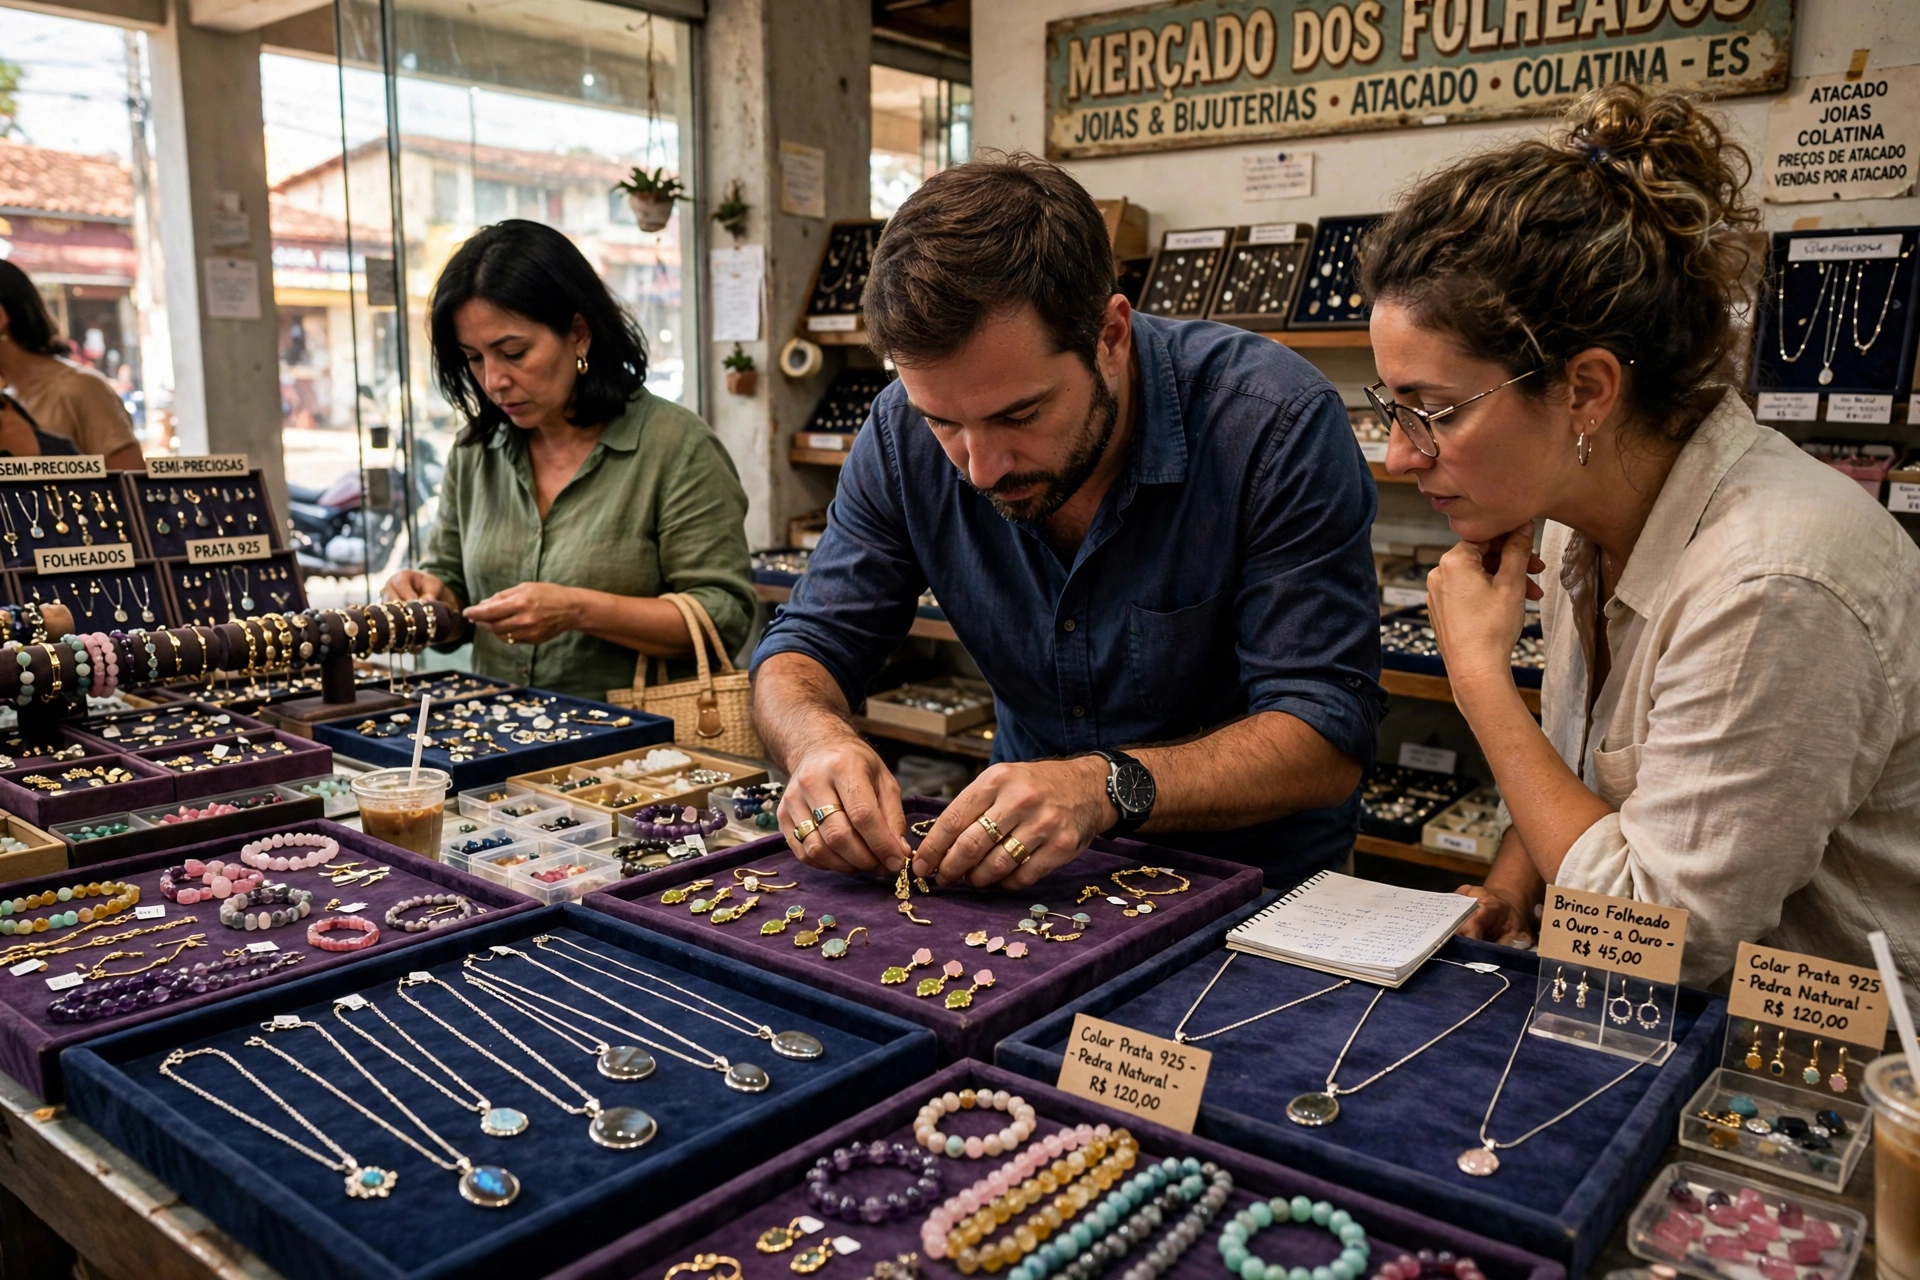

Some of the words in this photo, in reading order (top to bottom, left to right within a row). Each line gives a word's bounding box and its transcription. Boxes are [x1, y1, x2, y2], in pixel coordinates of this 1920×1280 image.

[1291, 0, 1384, 71] DOS
[1401, 0, 1754, 59] FOLHEA
[1075, 108, 1139, 144] JOIAS
[1148, 106, 1164, 135] &
[1173, 87, 1317, 134] BIJUTERIAS
[1350, 68, 1478, 116] ATACADO
[1513, 46, 1669, 98] COLATINA
[1707, 36, 1750, 78] ES
[1809, 80, 1889, 104] ATACADO
[1819, 103, 1871, 124] JOIAS
[1797, 123, 1885, 147] COLATINA
[1778, 150, 1825, 169] PREÇOS
[1828, 149, 1845, 164] DE
[1848, 144, 1906, 163] ATACADO
[1775, 170, 1820, 187] VENDAS
[1823, 169, 1847, 184] POR
[1850, 164, 1907, 183] ATACADO
[0, 460, 101, 476] SEMI-PRECIOSAS
[151, 459, 244, 474] SEMI-PRECIOSAS
[42, 550, 126, 569] FOLHEADOS
[194, 543, 234, 559] PRATA
[238, 541, 261, 555] 925
[1554, 895, 1599, 916] Brinco
[1606, 905, 1670, 930] Folheado
[1552, 919, 1561, 928] a
[1566, 917, 1599, 936] Ouro
[1613, 930, 1623, 941] a
[1628, 929, 1662, 948] Ouro
[1572, 939, 1591, 957] R$
[1598, 944, 1642, 965] 45,00
[1750, 954, 1791, 974] Colar
[1797, 963, 1841, 986] Prata
[1848, 974, 1881, 994] 925
[1750, 974, 1792, 997] Pedra
[1798, 985, 1860, 1011] Natural
[1763, 999, 1784, 1018] R$
[1792, 1006, 1849, 1030] 120,00
[1081, 1026, 1114, 1048] Colar
[1119, 1037, 1153, 1062] Prata
[1160, 1050, 1187, 1071] 925
[1078, 1048, 1112, 1073] Pedra
[1118, 1061, 1169, 1090] Natural
[1089, 1076, 1107, 1095] R$
[1113, 1083, 1161, 1110] 120,00
